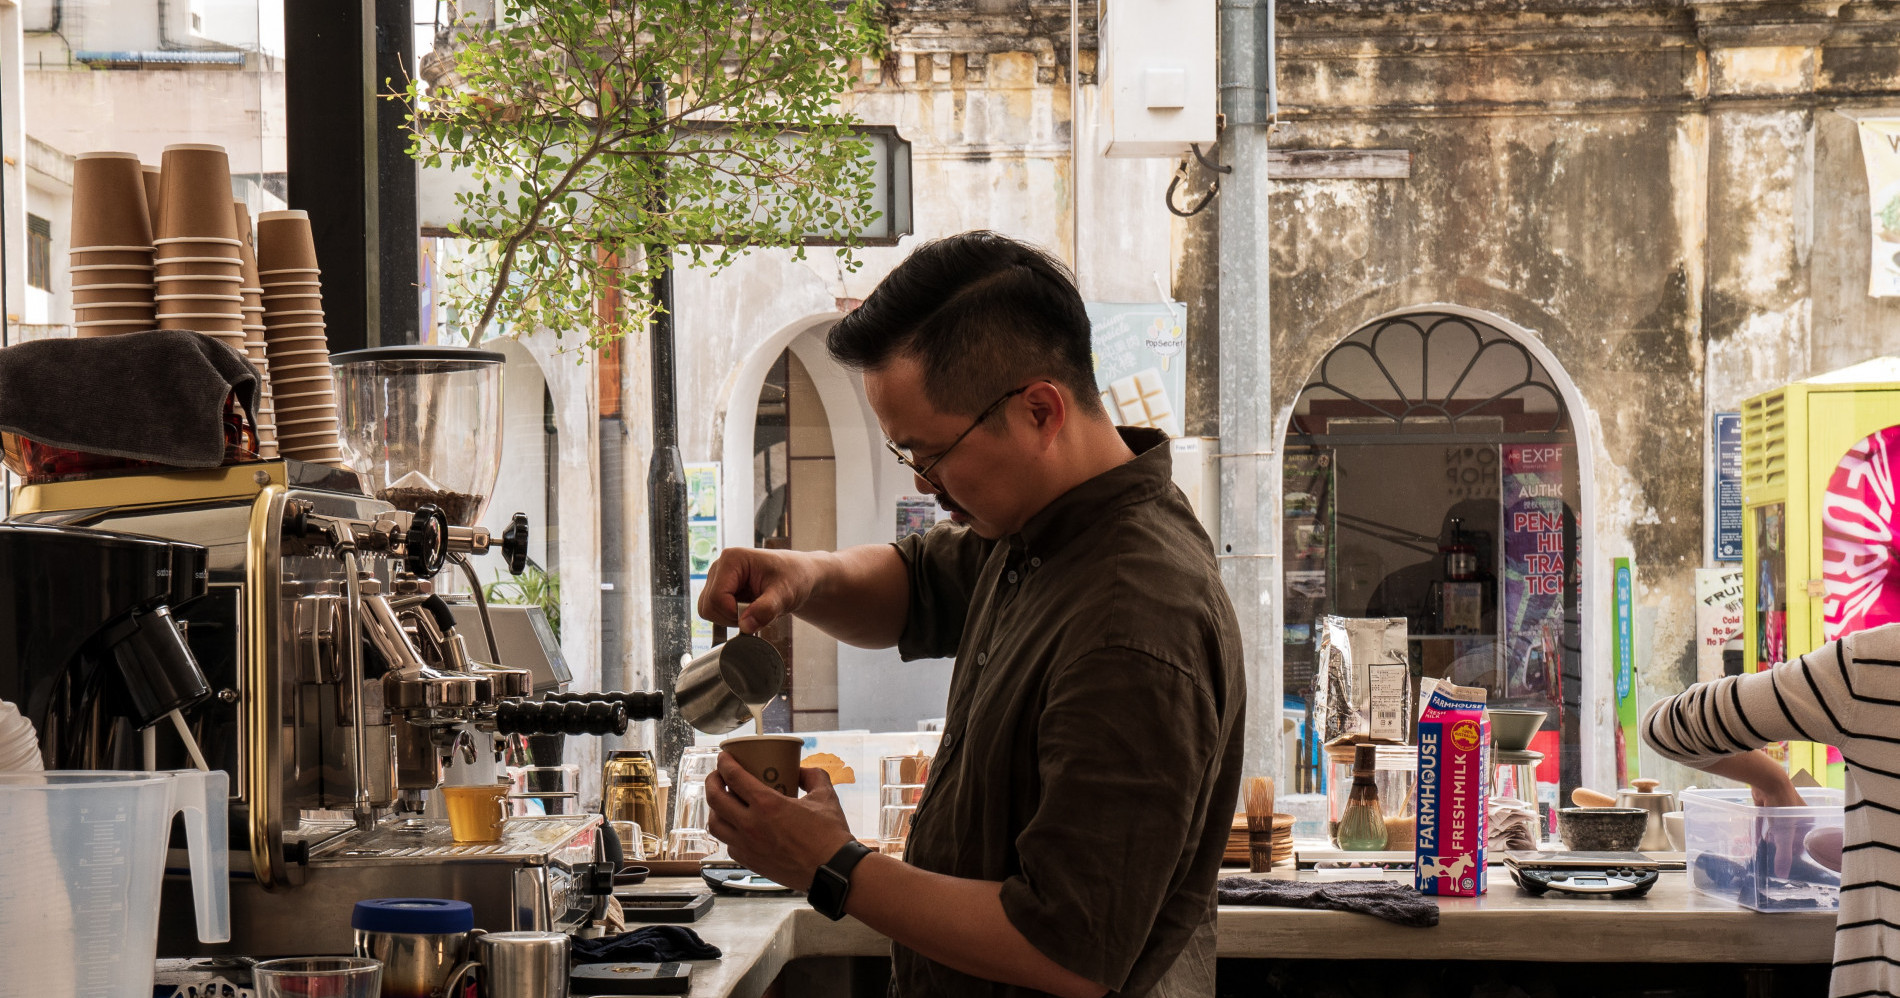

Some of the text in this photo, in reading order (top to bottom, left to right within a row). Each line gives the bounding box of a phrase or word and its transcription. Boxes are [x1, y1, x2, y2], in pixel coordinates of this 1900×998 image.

[1145, 339, 1184, 348] PopSecret
[1704, 585, 1743, 606] FRUI
[1432, 696, 1483, 709] FARMHOUSE
[1453, 753, 1467, 795] MILK
[1419, 733, 1437, 849] FARMHOUSE
[1452, 799, 1466, 850] FRESH
